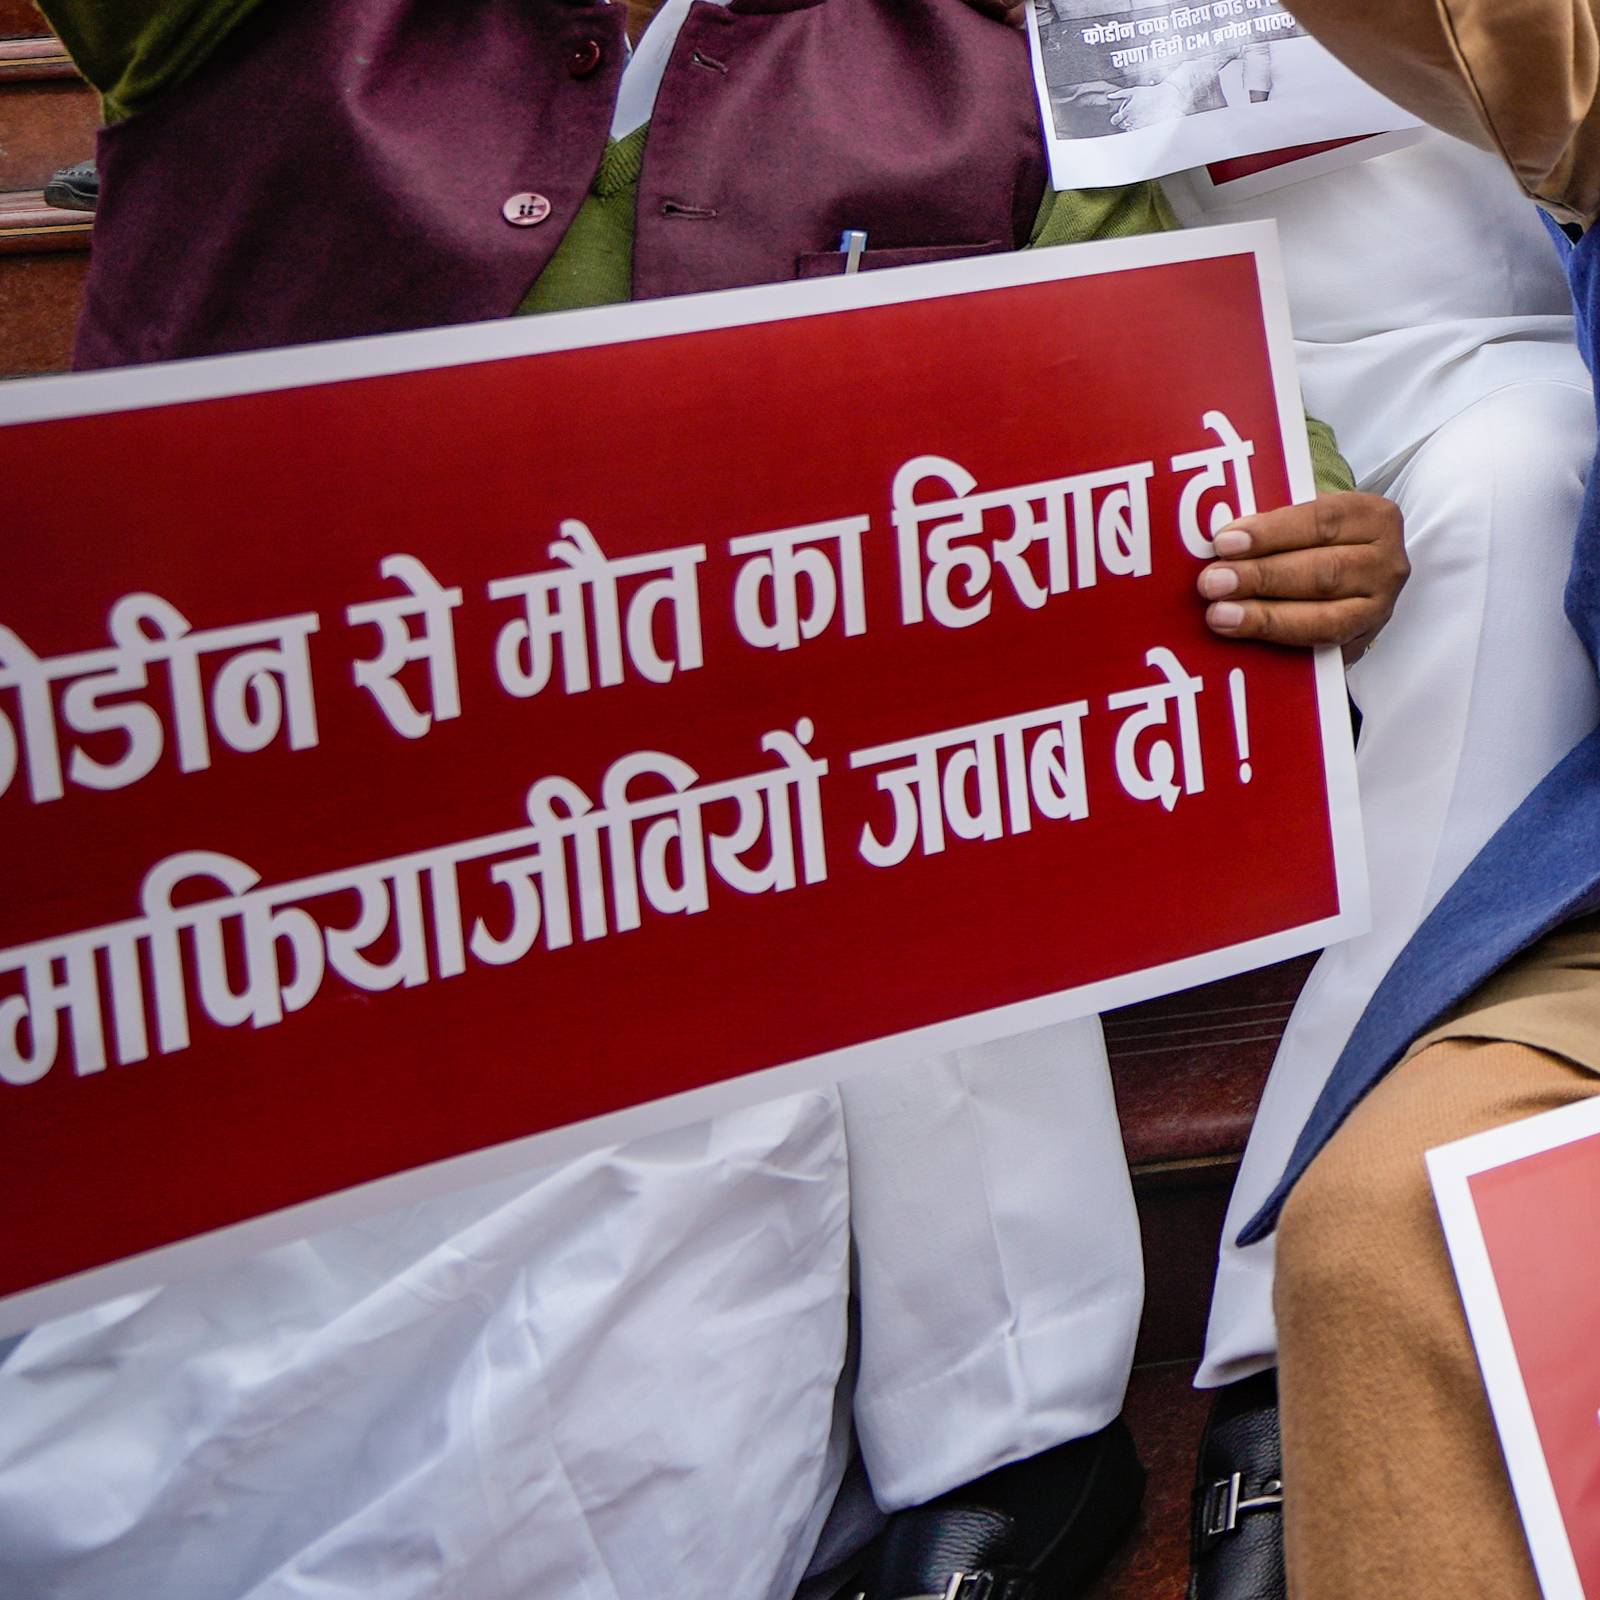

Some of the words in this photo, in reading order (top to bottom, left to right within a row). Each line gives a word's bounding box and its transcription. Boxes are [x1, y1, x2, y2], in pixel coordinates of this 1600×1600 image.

[1081, 21, 1135, 45] कोडीन
[1186, 36, 1209, 50] CM
[347, 554, 463, 738] से
[488, 519, 706, 697] मौत
[730, 515, 870, 650] का
[892, 456, 1154, 627] हिसाब
[850, 700, 1089, 867] जवाब
